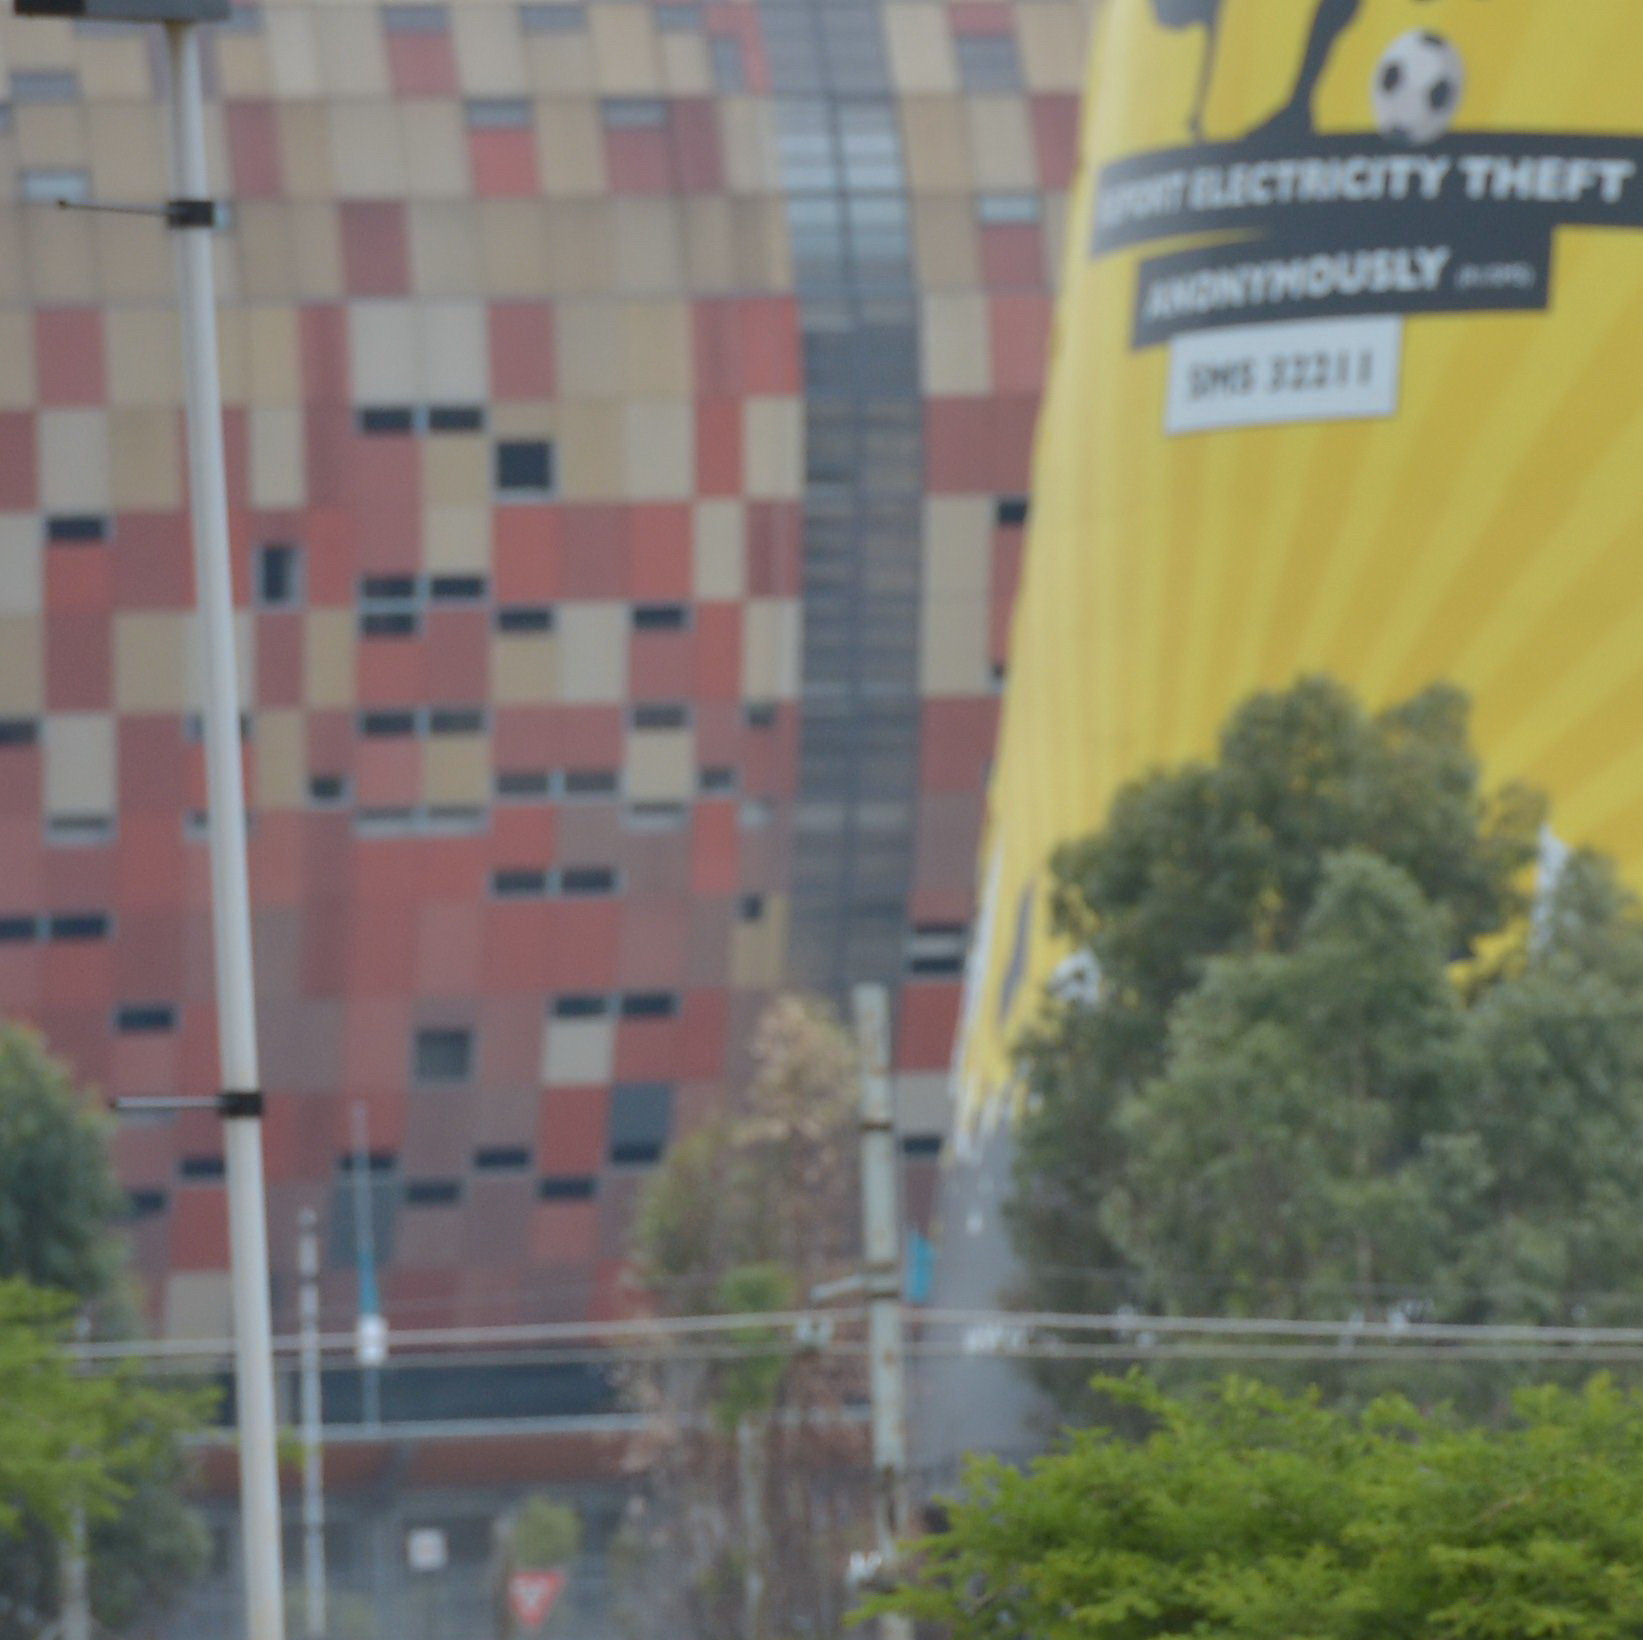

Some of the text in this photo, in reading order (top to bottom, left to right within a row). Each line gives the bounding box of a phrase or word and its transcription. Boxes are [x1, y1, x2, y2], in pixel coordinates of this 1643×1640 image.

[1190, 155, 1450, 211] ELECTRICITY
[1459, 156, 1638, 203] THEFT
[1142, 247, 1451, 319] ANONYMOUSLY
[1189, 354, 1255, 399] SMS
